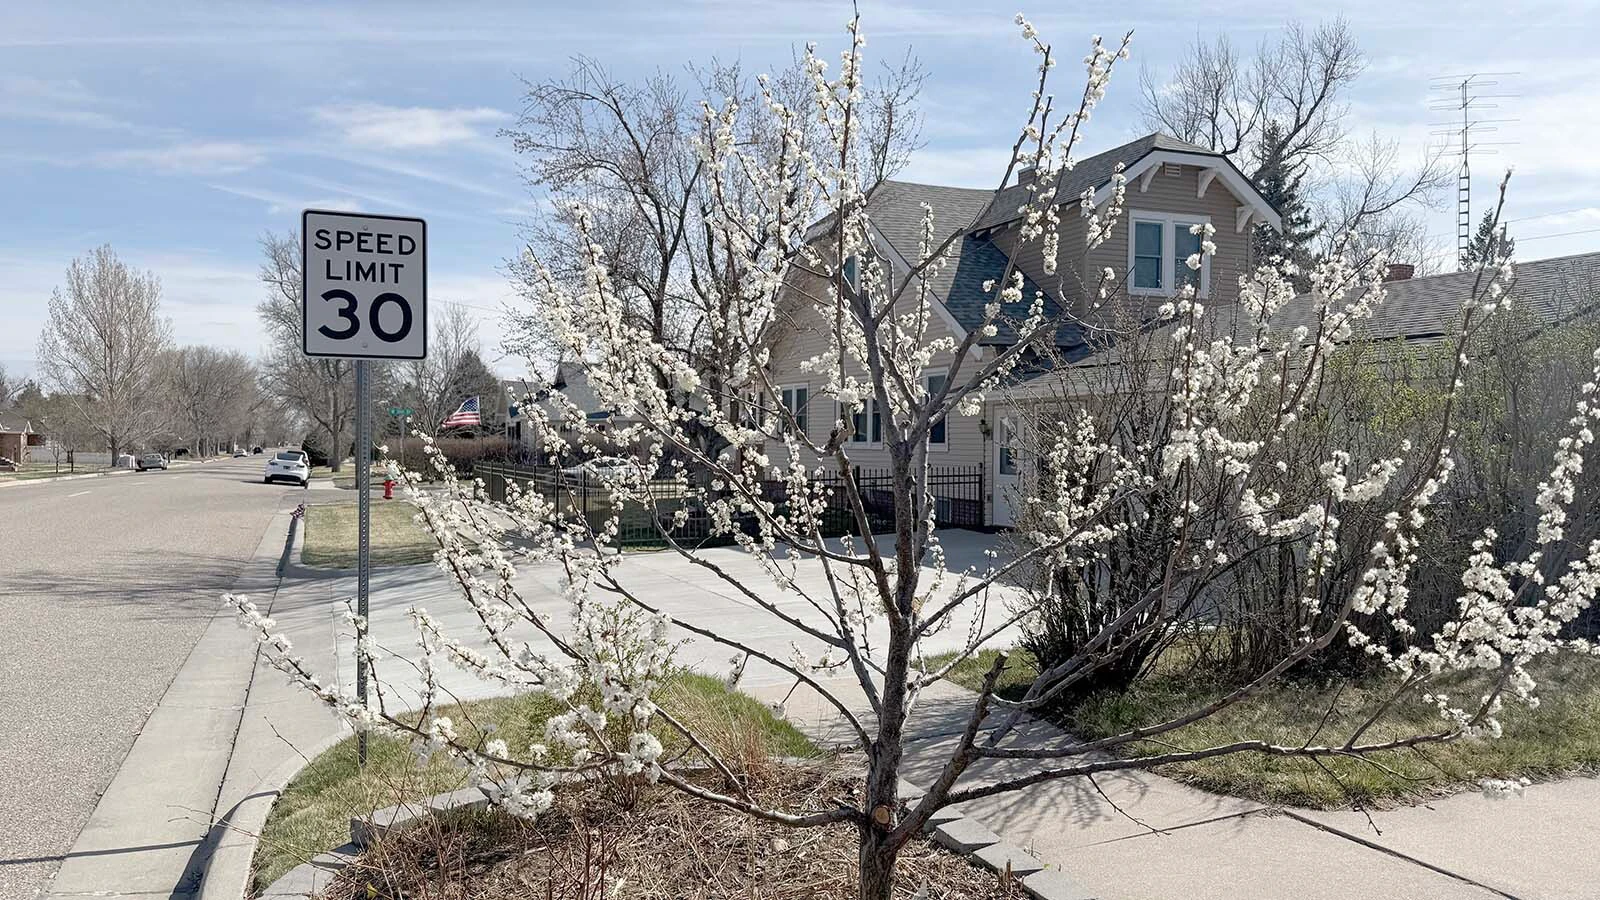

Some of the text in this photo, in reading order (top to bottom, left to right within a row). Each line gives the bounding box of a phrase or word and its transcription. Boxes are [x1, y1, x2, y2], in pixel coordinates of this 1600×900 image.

[314, 229, 416, 255] SPEED
[326, 259, 404, 284] LIMIT
[318, 289, 412, 343] 30
